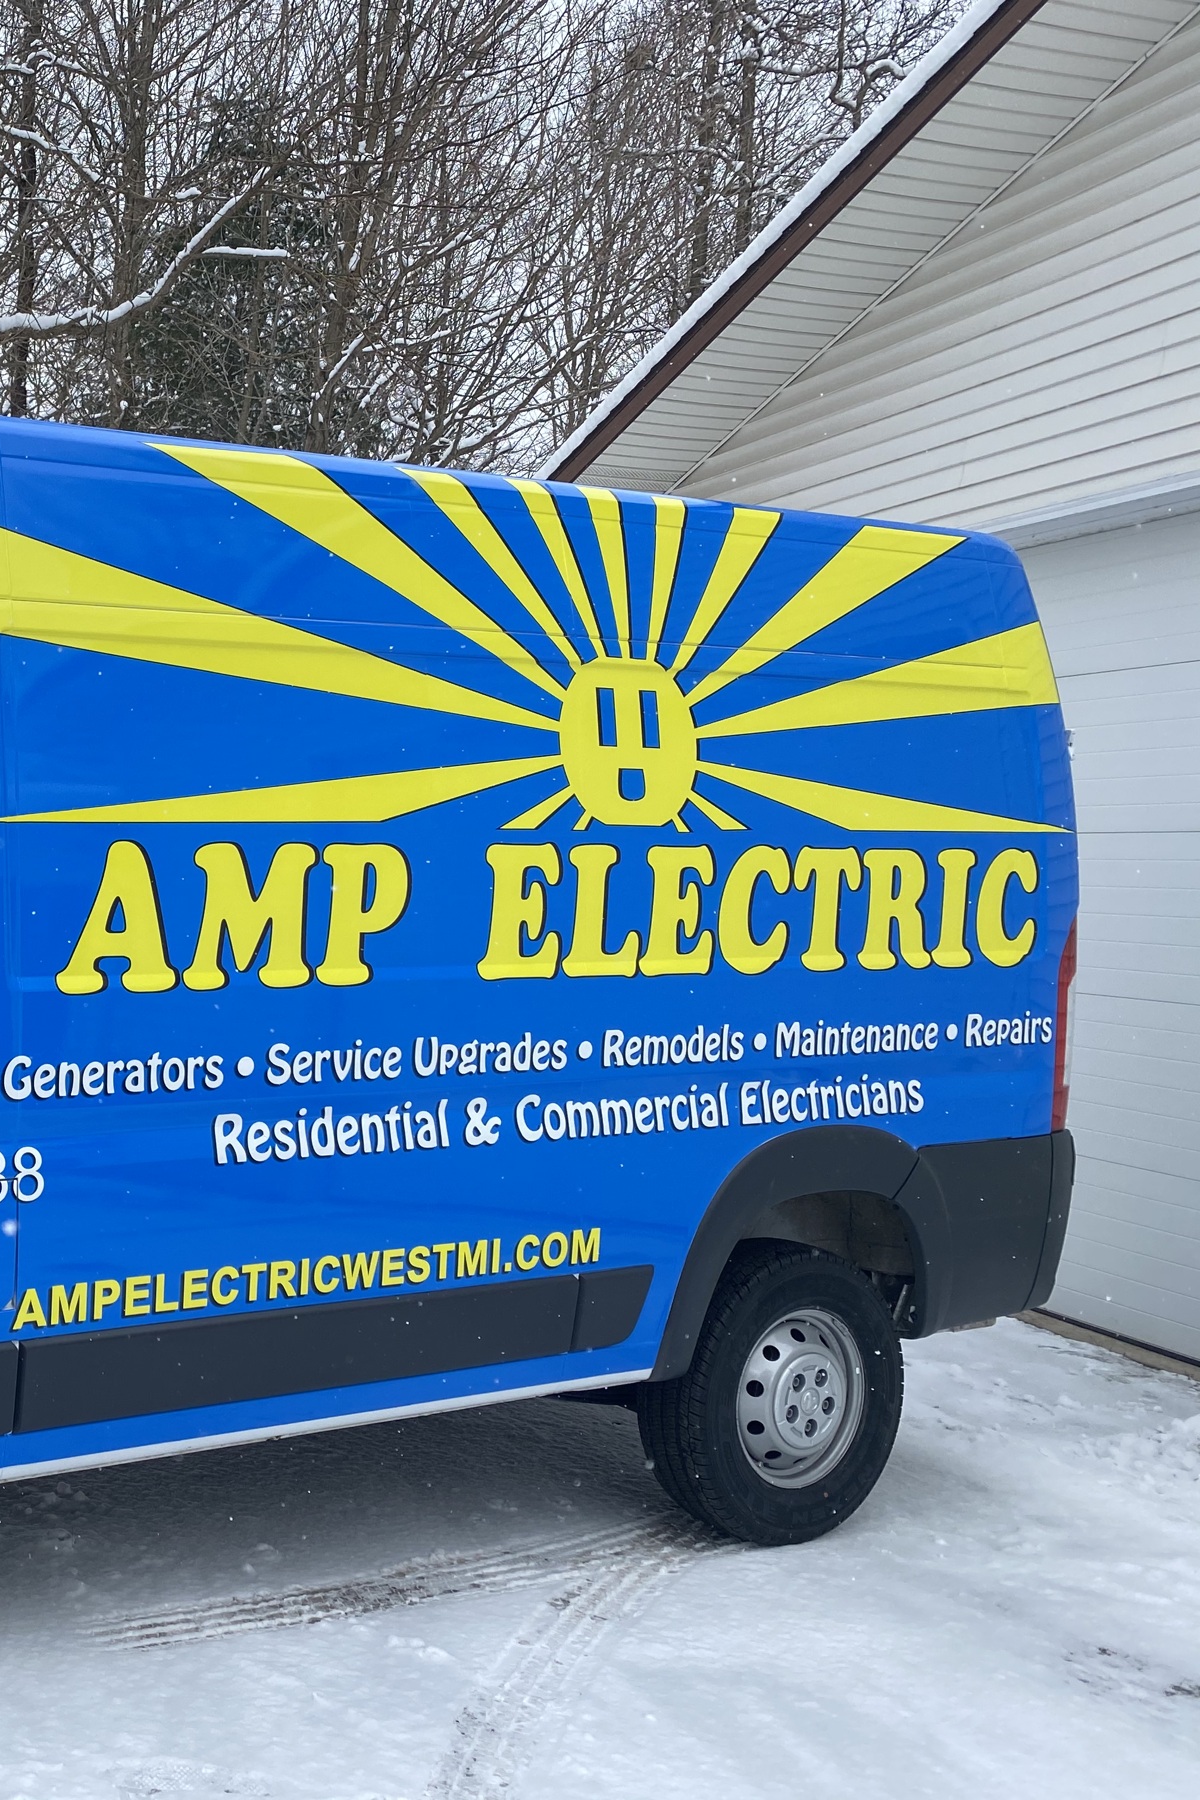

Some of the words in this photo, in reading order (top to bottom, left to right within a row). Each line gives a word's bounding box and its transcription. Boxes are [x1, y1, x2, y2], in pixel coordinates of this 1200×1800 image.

[55, 840, 412, 995] AMP
[476, 842, 1039, 980] ELECTRIC
[3, 1051, 224, 1100] Generators
[267, 1039, 402, 1085] Service
[414, 1032, 568, 1077] Upgrades
[603, 1023, 744, 1067] Remodels
[775, 1017, 940, 1059] Maintenance
[964, 1010, 1054, 1048] Repairs
[214, 1098, 450, 1164] Residential
[465, 1097, 502, 1146] &
[516, 1082, 729, 1142] Commercial
[740, 1073, 925, 1126] Electricians
[11, 1227, 602, 1331] AMPELECTRICWESTMI.COM
